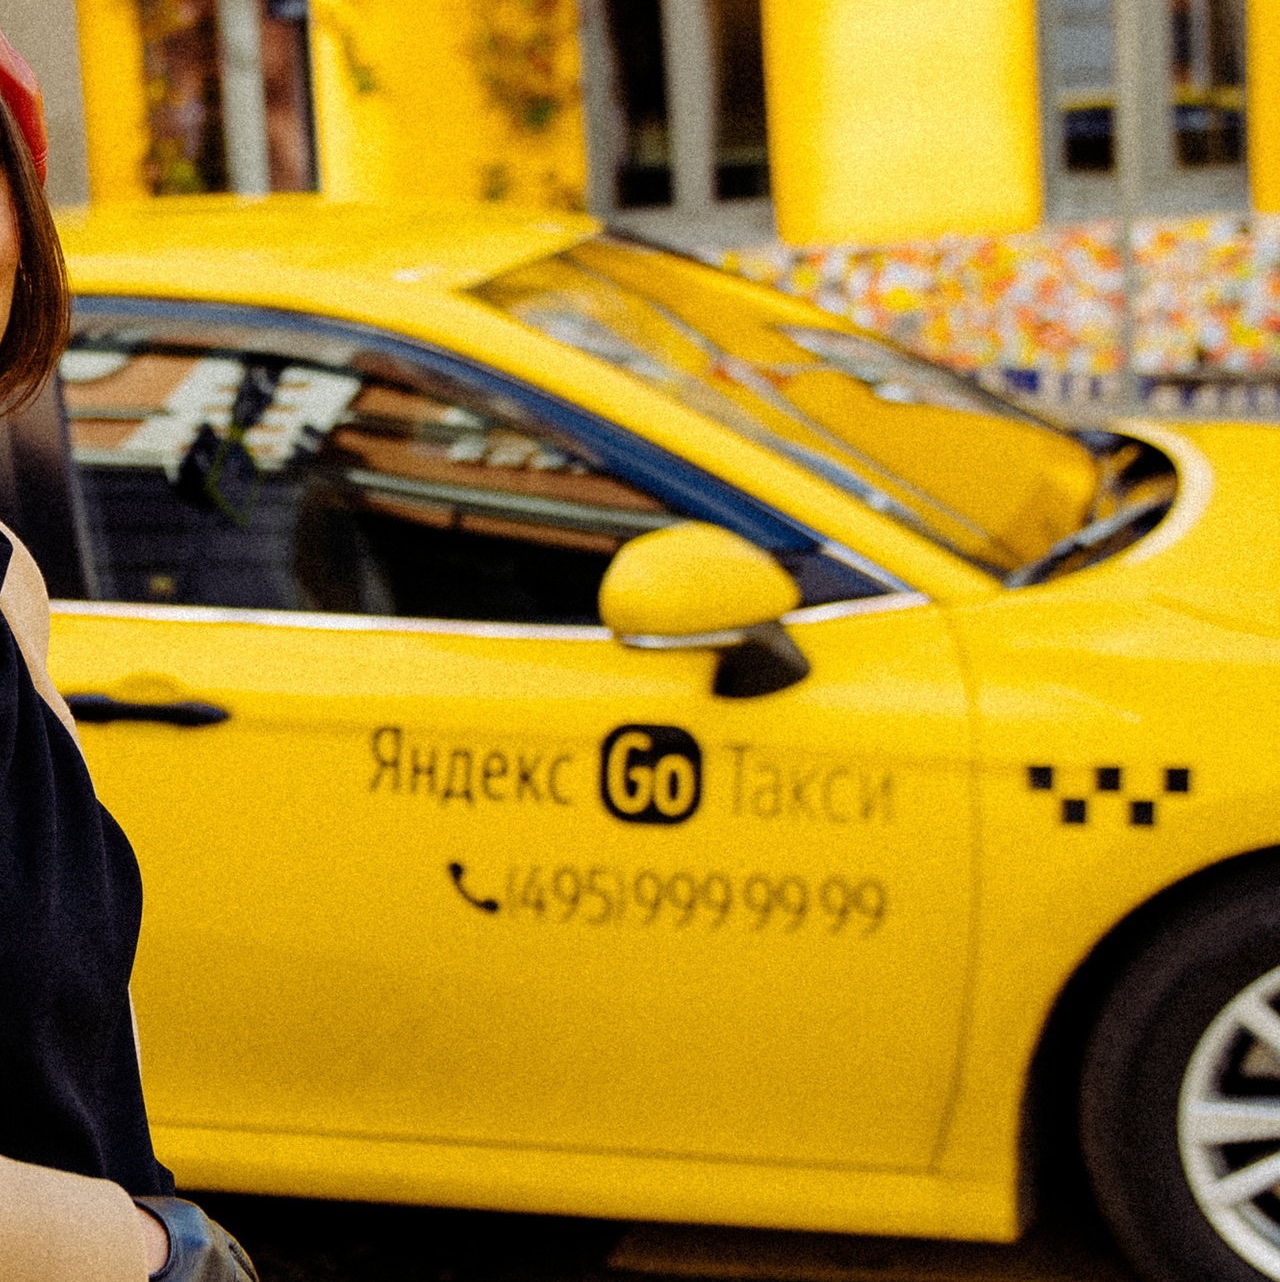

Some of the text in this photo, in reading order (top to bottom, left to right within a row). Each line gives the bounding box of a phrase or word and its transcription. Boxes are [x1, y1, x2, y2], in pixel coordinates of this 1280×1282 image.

[370, 724, 894, 822] Яндекс Go Такси
[633, 869, 732, 929] 999
